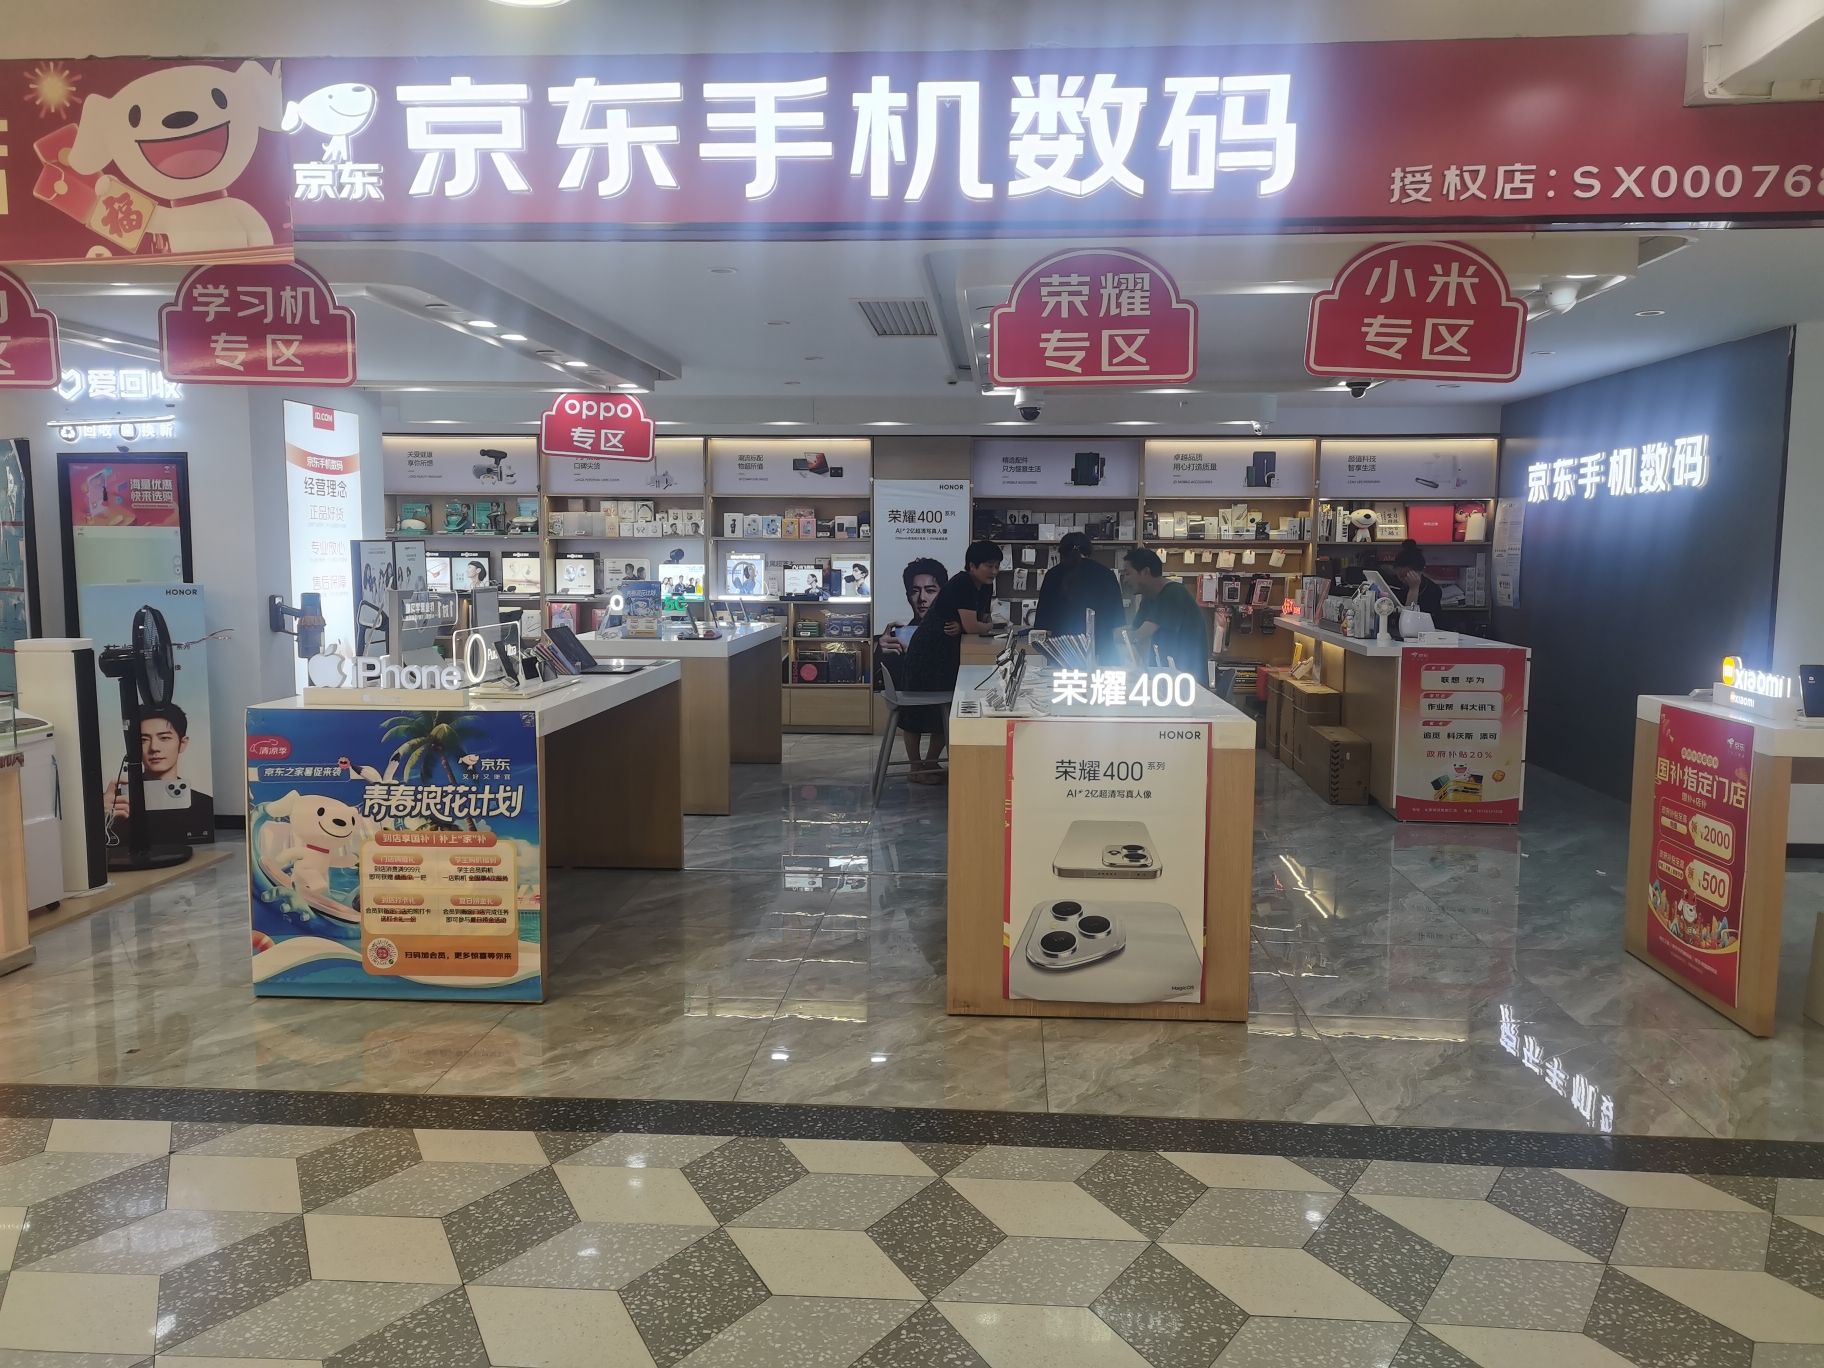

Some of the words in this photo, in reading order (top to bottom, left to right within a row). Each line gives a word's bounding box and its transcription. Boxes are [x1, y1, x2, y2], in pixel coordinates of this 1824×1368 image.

[394, 73, 1297, 203] 京东手机数码
[293, 162, 384, 201] 京东
[1039, 271, 1152, 318] 荣耀
[1364, 258, 1480, 307] 小米
[192, 284, 319, 326] 学习机
[210, 332, 305, 373] 专区
[1039, 328, 1151, 374] 专区
[1361, 314, 1475, 362] 专区
[564, 399, 632, 421] oppo
[570, 426, 625, 452] 专区
[303, 476, 349, 499] 经营理念
[1527, 434, 1709, 503] 京东手机数码
[887, 508, 943, 524] 荣耀400
[165, 588, 198, 596] HONOR
[350, 653, 462, 690] iPhone
[1051, 668, 1197, 707] 荣耀400
[1159, 730, 1201, 740] HONOR
[480, 758, 511, 771] 京东
[1055, 759, 1144, 782] 荣耀400
[1147, 761, 1166, 771] 系列
[1657, 756, 1747, 809] 国补指定门店
[362, 783, 525, 823] 青春浪花计划
